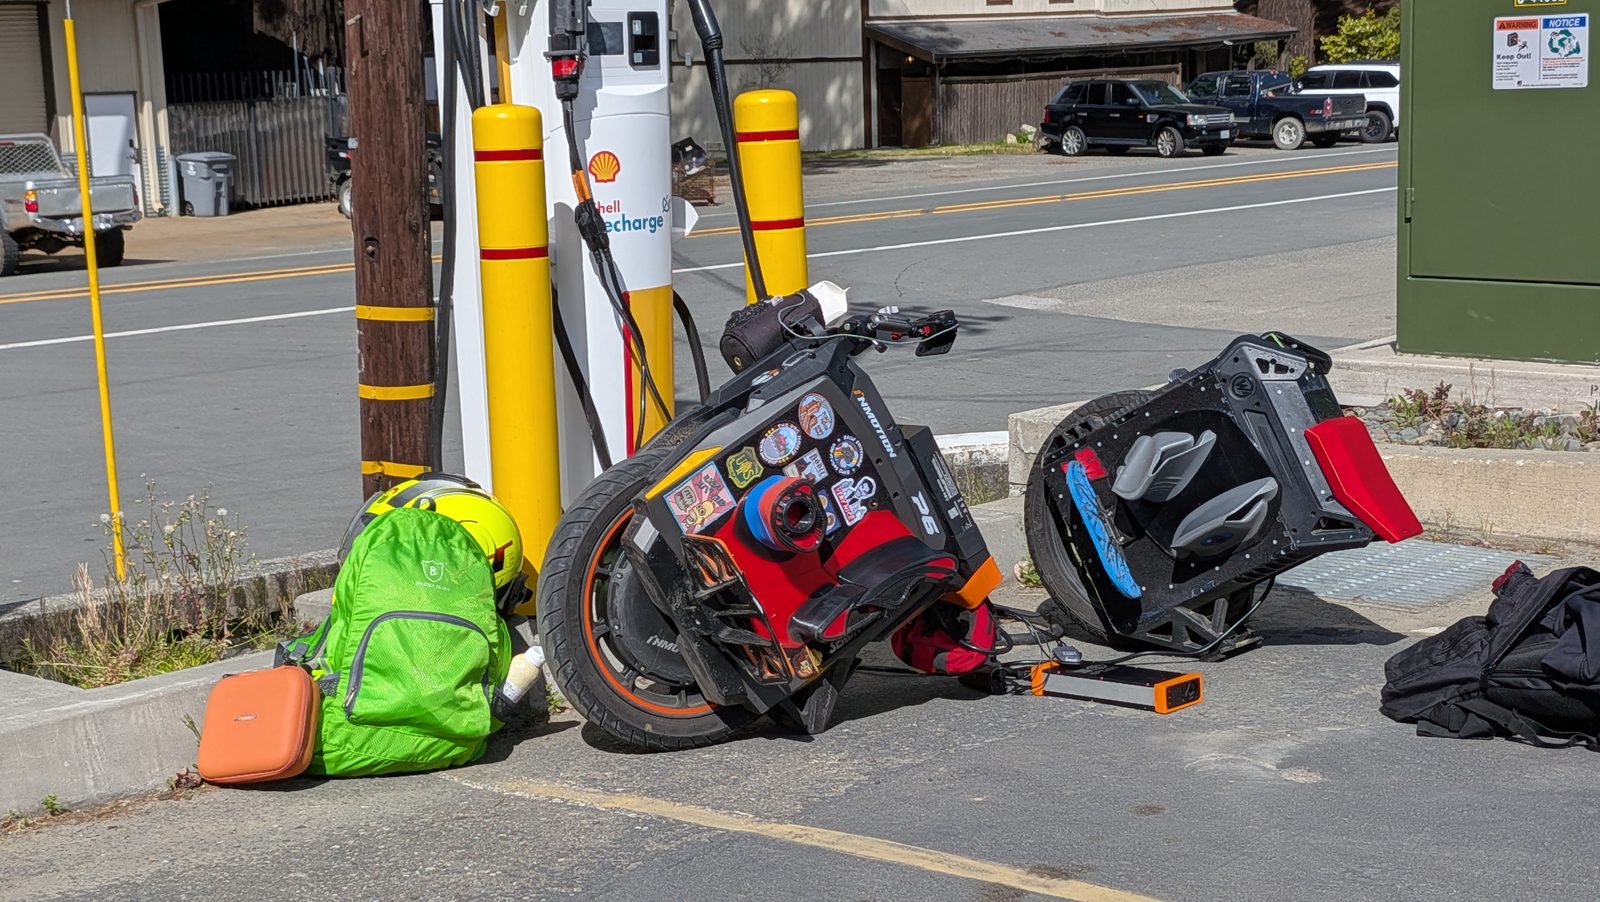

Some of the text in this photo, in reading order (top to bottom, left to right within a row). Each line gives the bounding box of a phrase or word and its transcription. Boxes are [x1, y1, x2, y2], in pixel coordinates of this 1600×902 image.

[1505, 21, 1537, 29] WARNING
[1548, 18, 1580, 28] NOTICE
[604, 213, 663, 234] echarge
[842, 502, 855, 520] NICE
